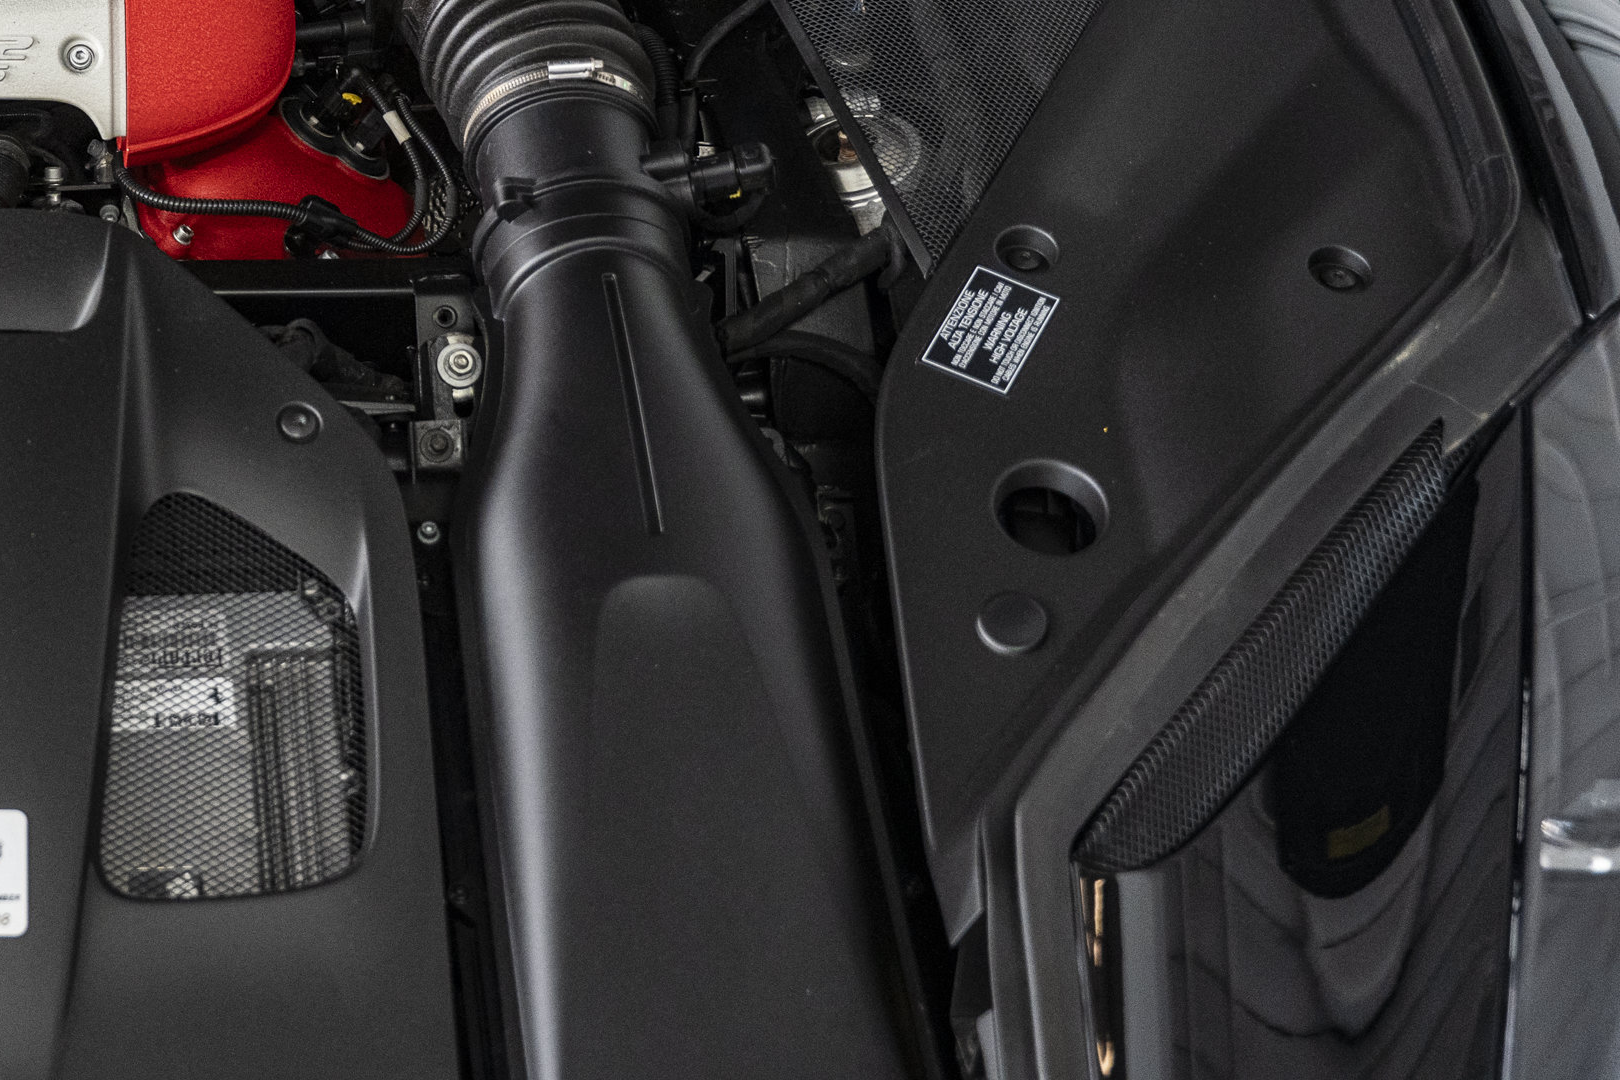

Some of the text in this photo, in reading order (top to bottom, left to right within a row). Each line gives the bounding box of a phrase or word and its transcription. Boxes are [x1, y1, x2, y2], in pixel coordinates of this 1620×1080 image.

[940, 289, 976, 341] ATTENZIONE
[948, 289, 988, 349] ALTA TENSIONE
[982, 311, 1011, 350] WARNING
[989, 307, 1027, 363] HIGH VOLTAGE
